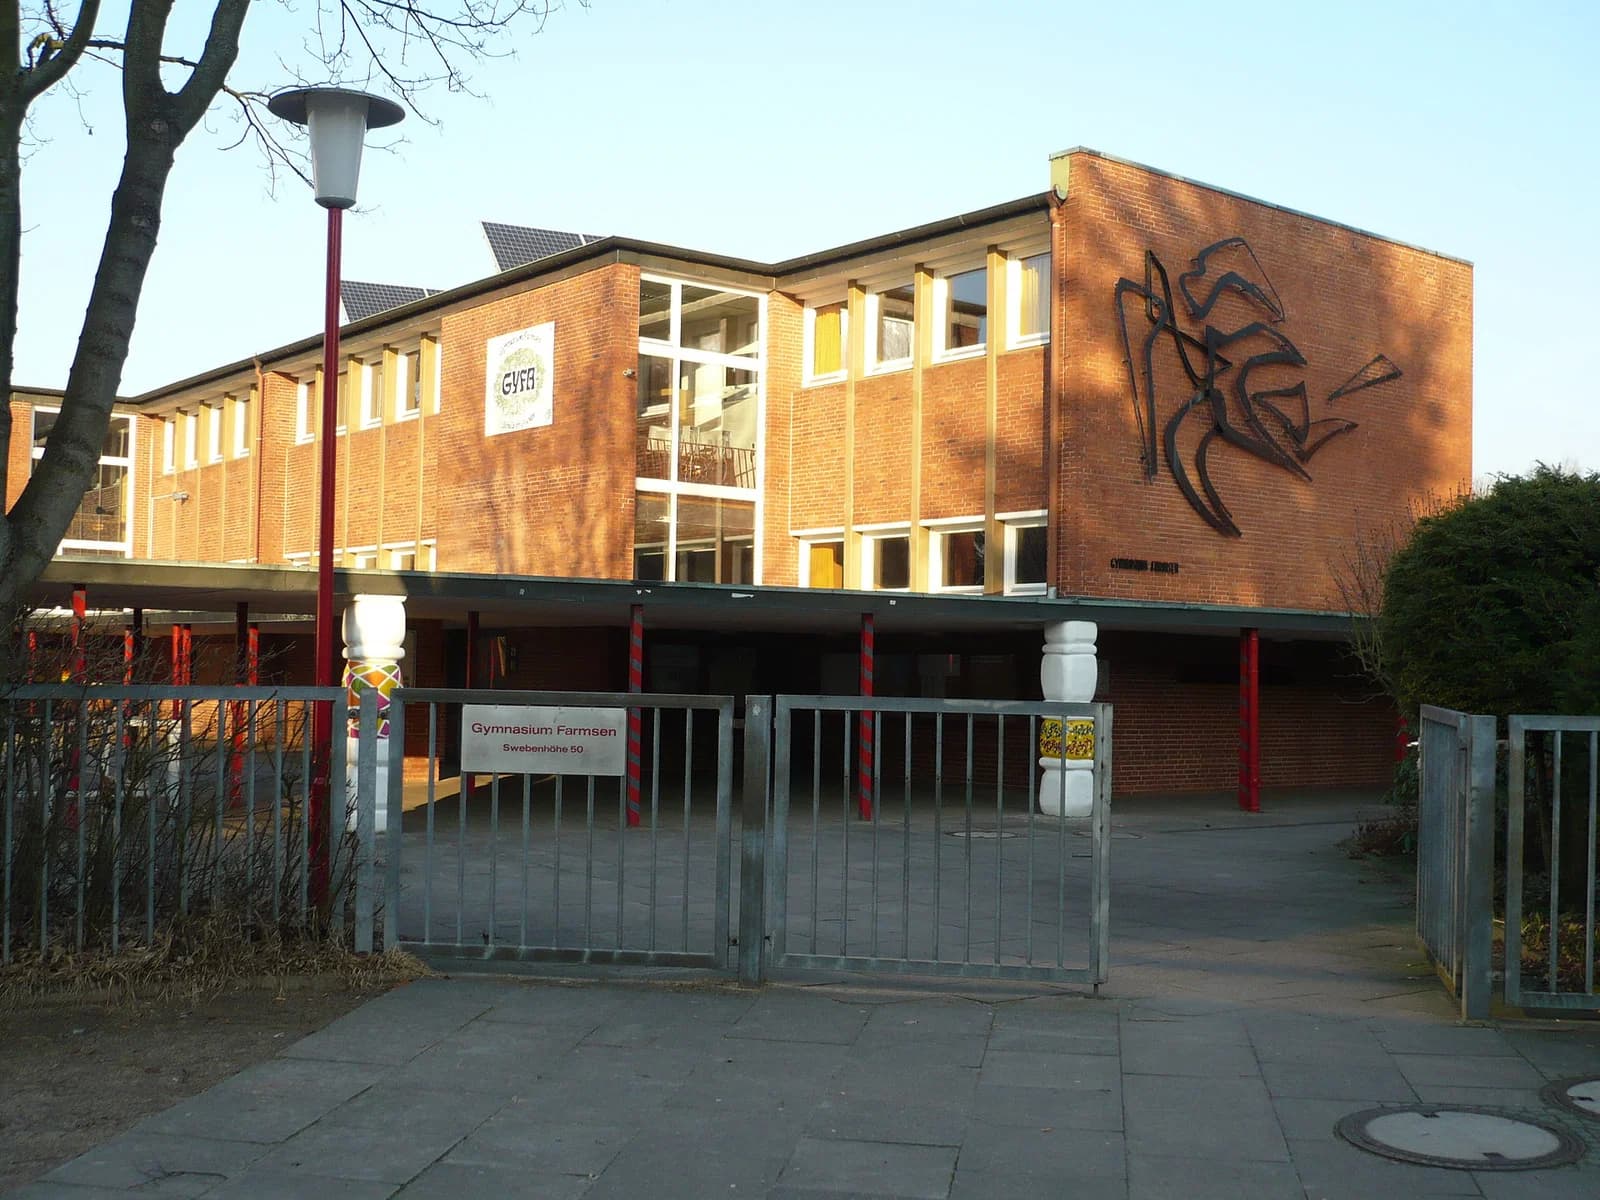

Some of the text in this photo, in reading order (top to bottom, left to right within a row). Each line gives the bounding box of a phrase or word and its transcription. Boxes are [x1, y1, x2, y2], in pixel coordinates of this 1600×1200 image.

[502, 367, 535, 395] GYFA
[471, 723, 617, 737] Gymnasium Farmsen
[503, 743, 584, 754] Swebenhöhe 50
